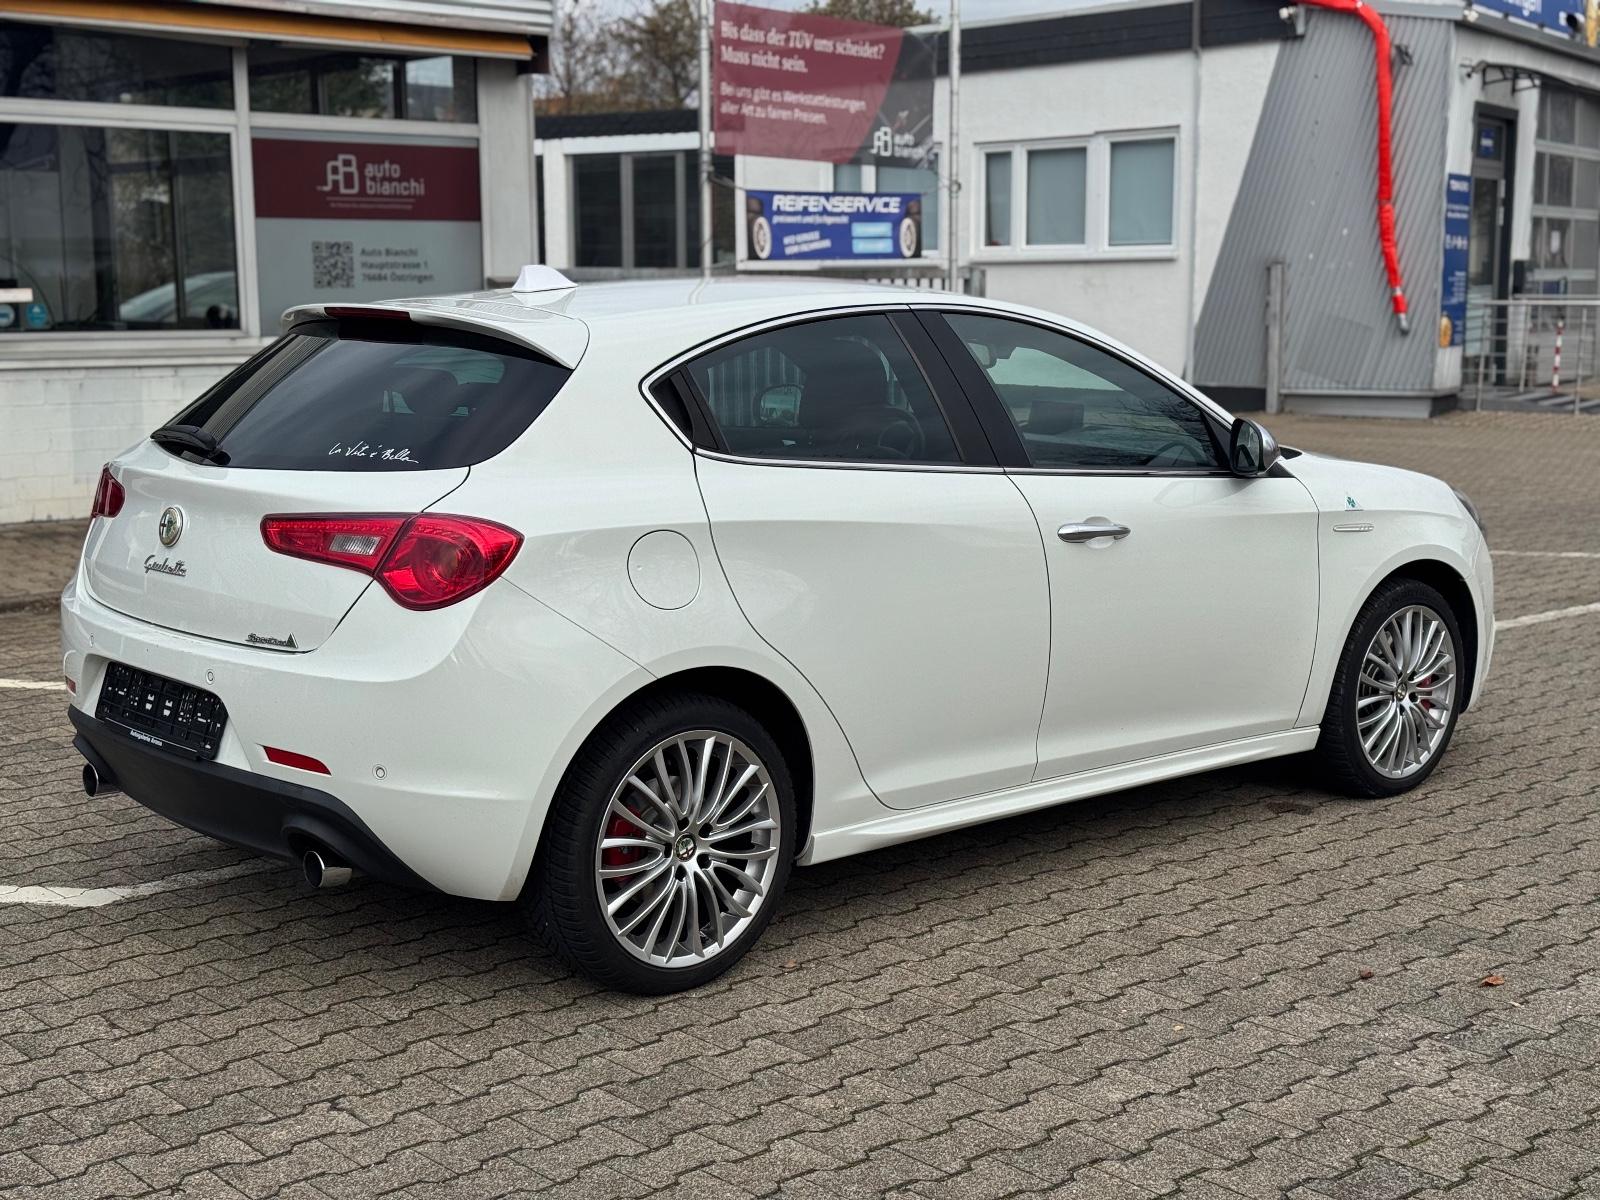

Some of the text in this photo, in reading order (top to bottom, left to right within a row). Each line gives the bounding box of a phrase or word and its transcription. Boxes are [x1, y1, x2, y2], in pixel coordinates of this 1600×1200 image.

[720, 20, 885, 60] Bis dass der TÜV uns scheidet?
[720, 44, 808, 72] Muss nicht sein.
[364, 160, 401, 178] auto
[366, 178, 425, 196] bianchi
[772, 193, 902, 214] REIFENSERVICE
[360, 247, 418, 257] Auto Bianchi
[361, 261, 421, 271] Hauptstrasse
[381, 448, 419, 464] Bella
[144, 555, 187, 577] Giulietta
